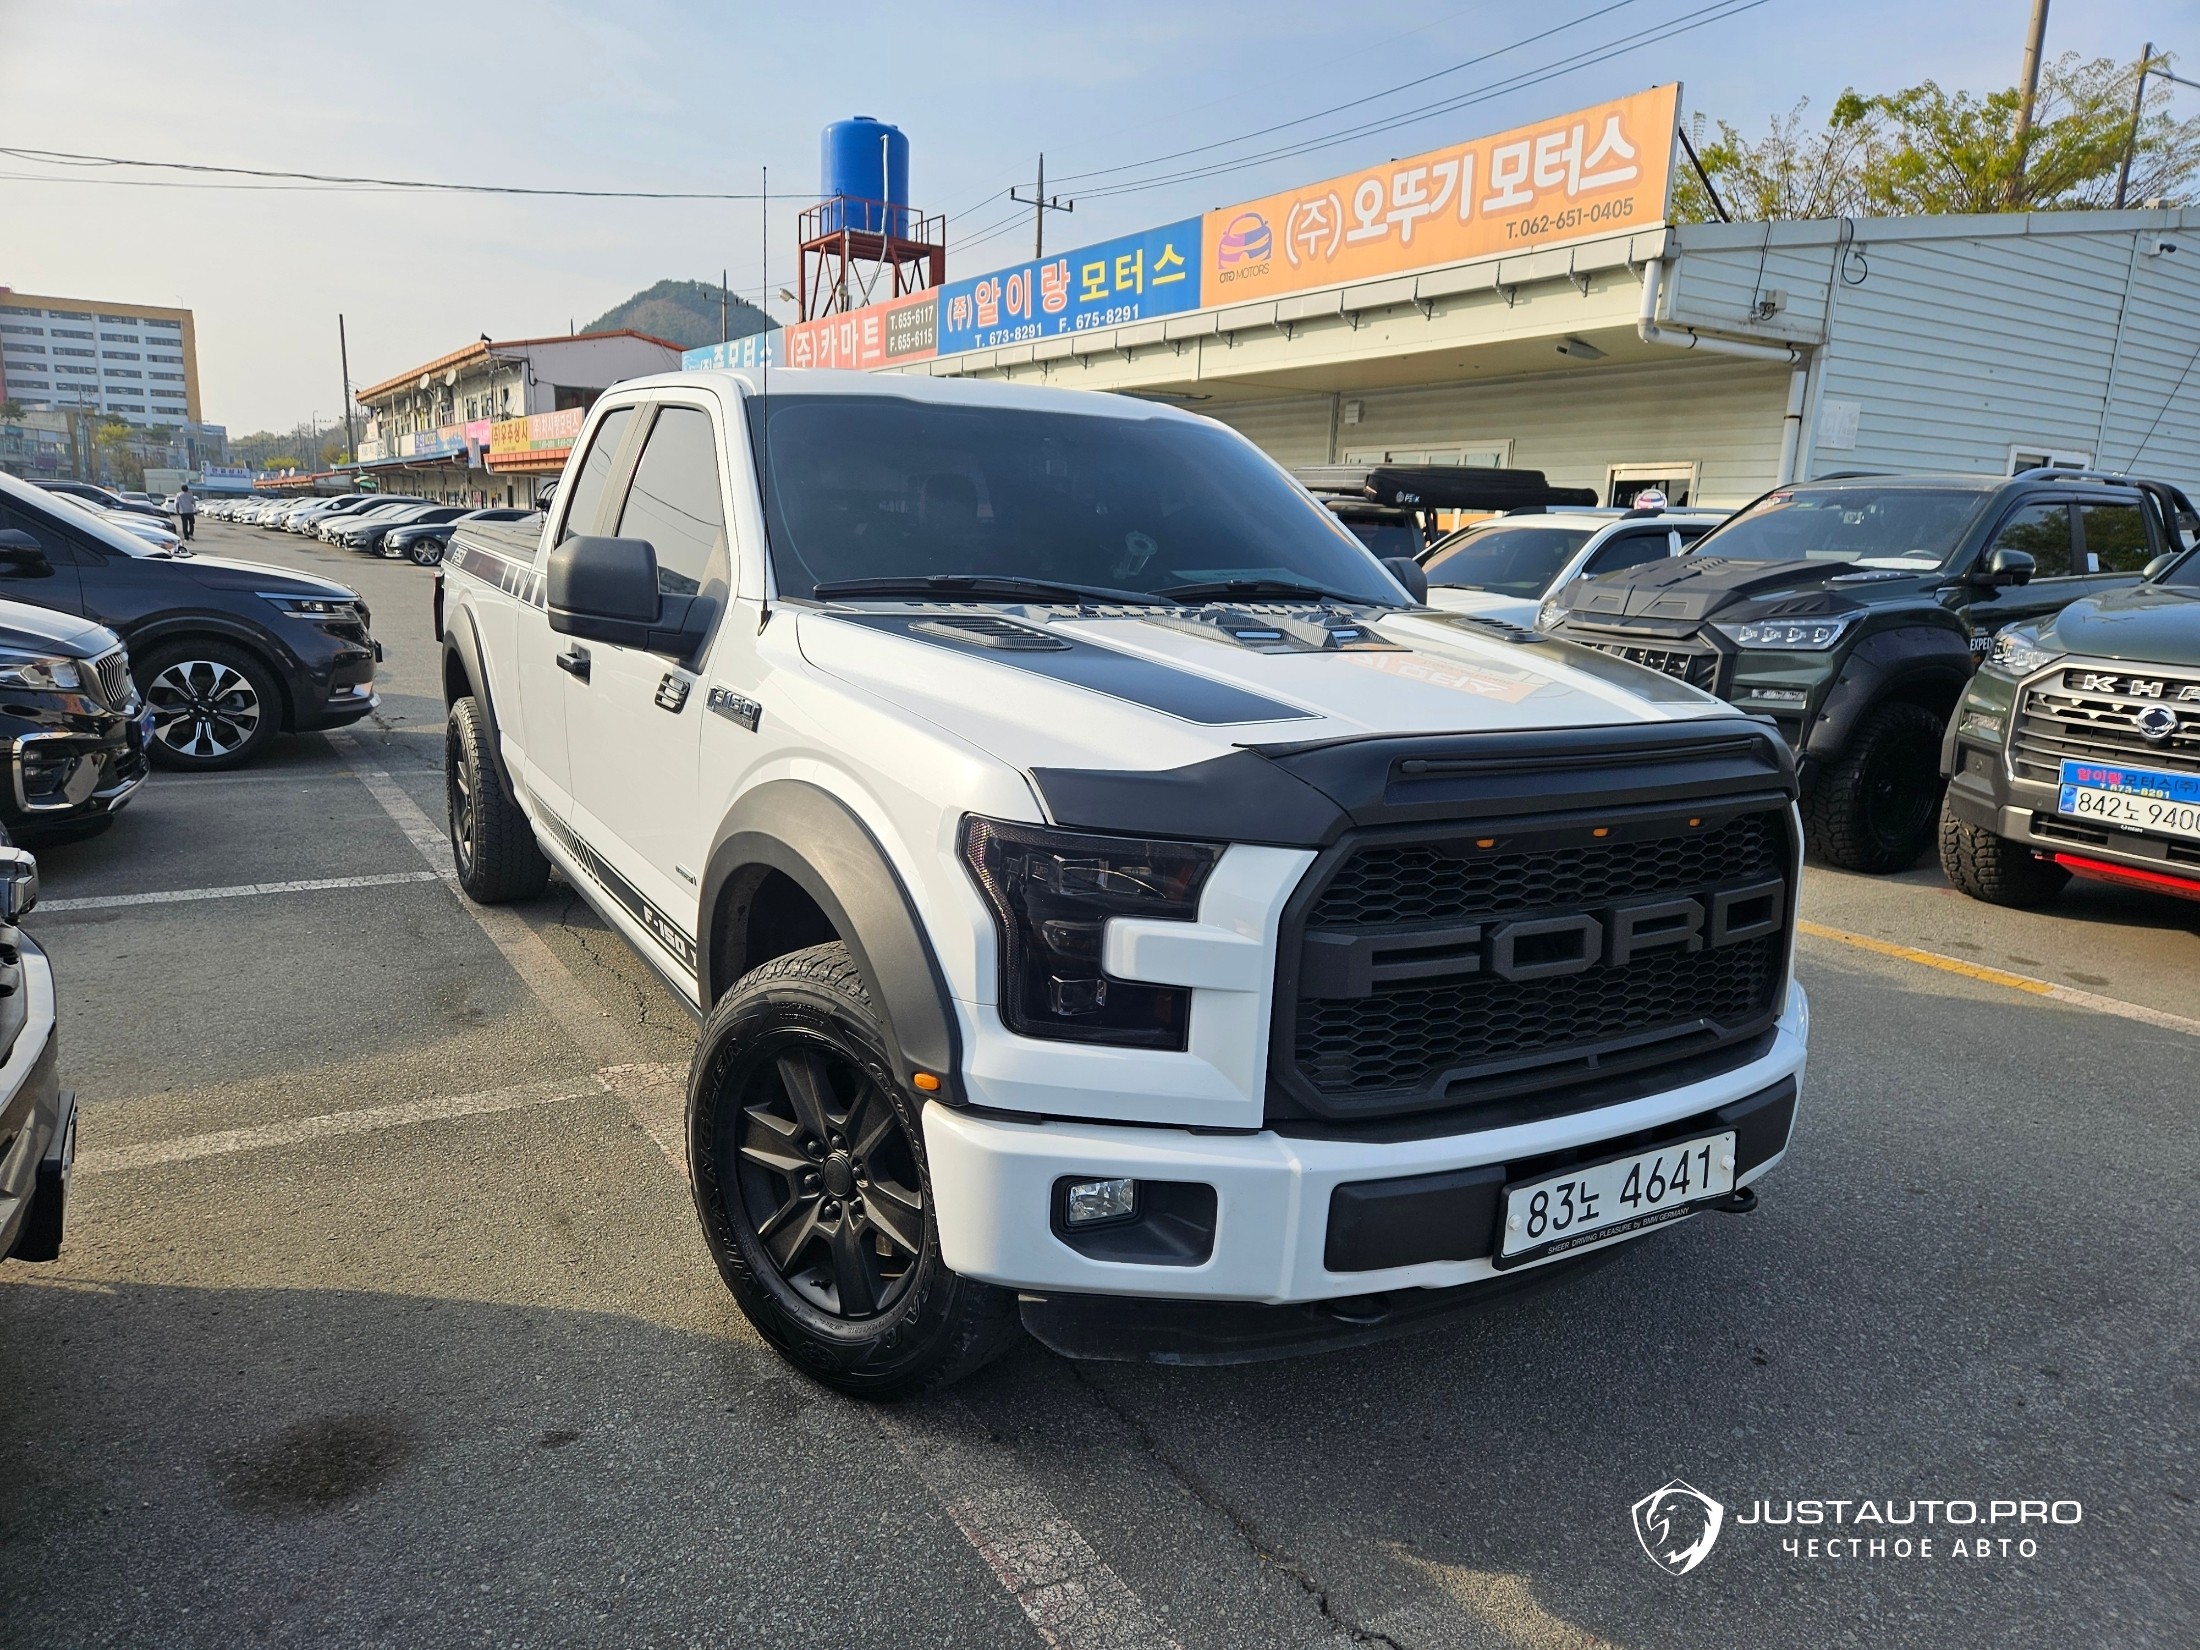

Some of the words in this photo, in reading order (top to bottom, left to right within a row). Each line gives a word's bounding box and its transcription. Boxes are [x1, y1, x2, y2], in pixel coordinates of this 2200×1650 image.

[1285, 154, 1474, 265] (주)오뚜기
[1482, 115, 1638, 213] 모터스
[1505, 197, 1634, 240] T.062-651-0405
[1236, 262, 1270, 279] MOTORS
[790, 316, 881, 368] (주)카마트
[492, 421, 528, 447] (주)우주상사
[2078, 792, 2140, 821] 842노
[643, 904, 687, 959] F-150
[1303, 877, 1785, 999] FORD
[1526, 1180, 1600, 1239] 83노
[1619, 1144, 1711, 1209] 4641
[1547, 1241, 1570, 1255] SHEER
[1571, 1232, 1598, 1248] DRIVING
[1599, 1223, 1632, 1240] PLEASURE
[1633, 1221, 1642, 1230] by
[1642, 1214, 1660, 1226] BMW
[1659, 1207, 1690, 1222] GERMANY
